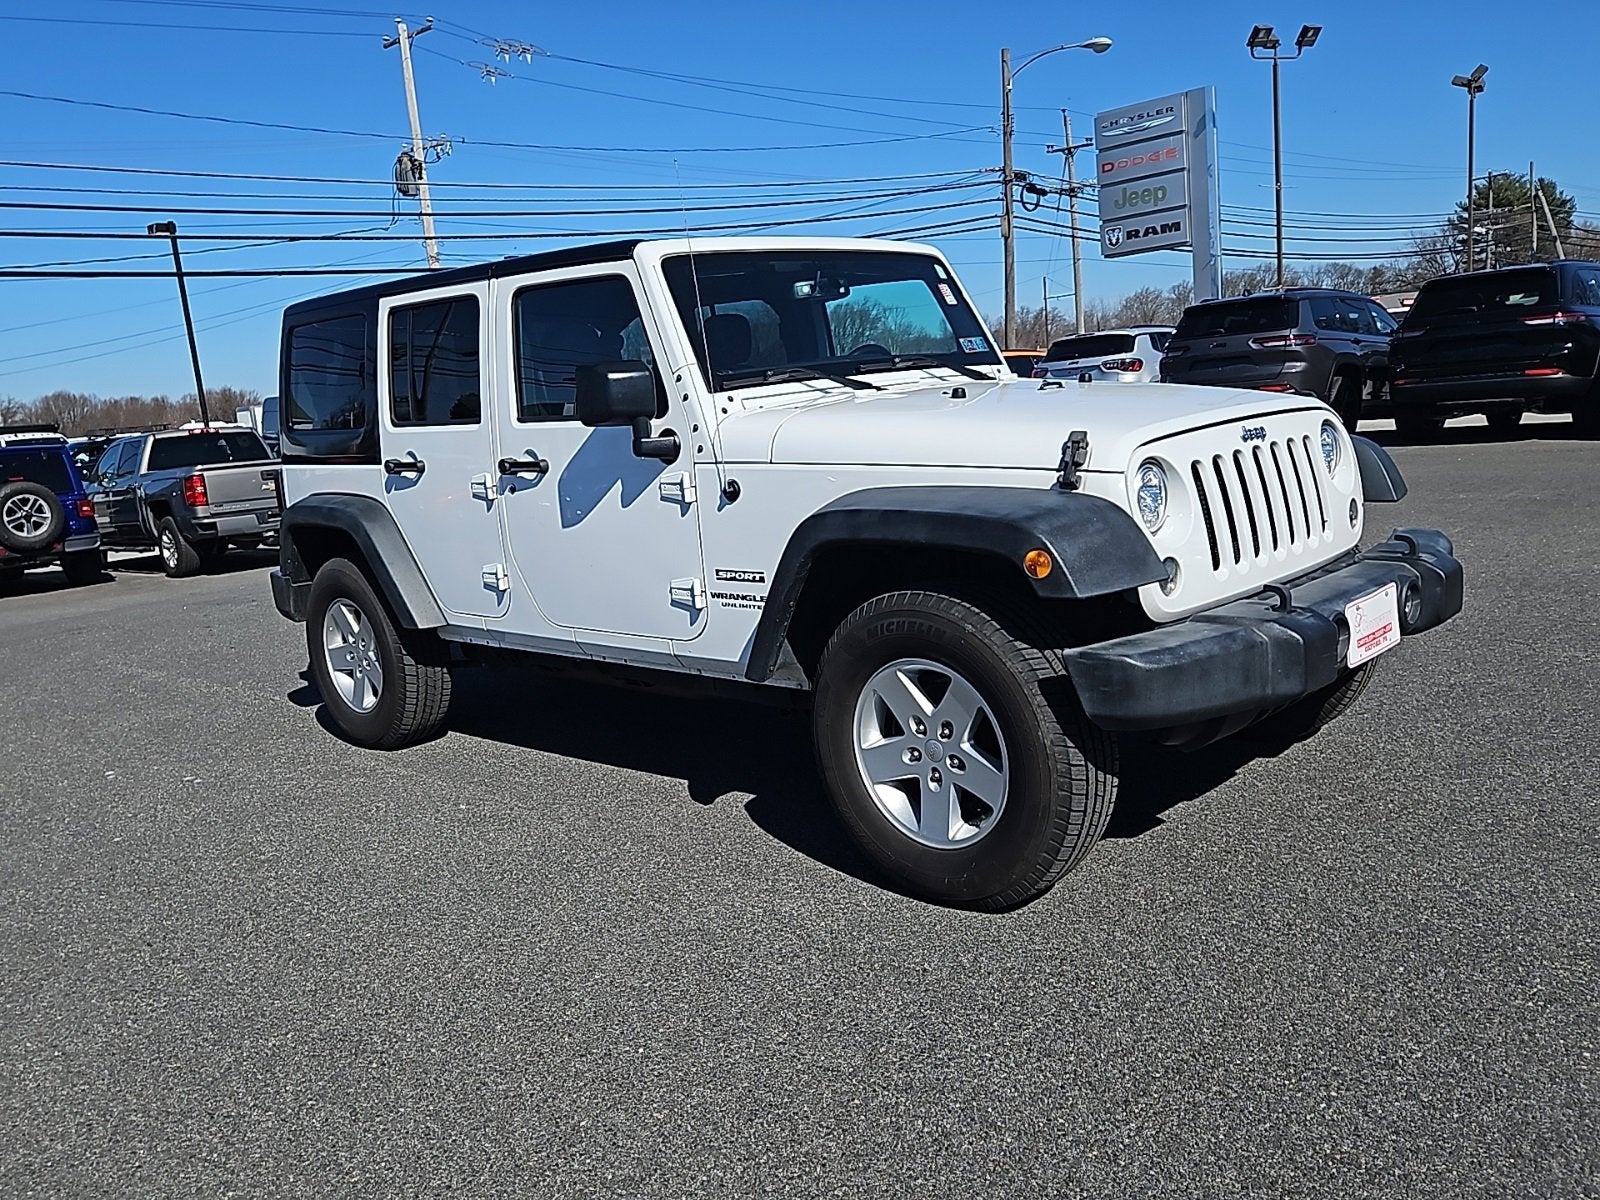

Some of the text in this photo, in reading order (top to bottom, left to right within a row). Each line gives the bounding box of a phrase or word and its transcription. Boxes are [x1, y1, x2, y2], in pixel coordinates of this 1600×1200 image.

[1102, 106, 1175, 129] CHRYSLER
[1101, 147, 1179, 174] DODGE
[1113, 184, 1168, 210] Jeep
[1126, 220, 1182, 241] RAM
[1240, 425, 1267, 443] Jeep
[716, 570, 764, 582] SPORT
[710, 591, 767, 602] WRANGLE
[721, 601, 763, 610] UNLIMITE
